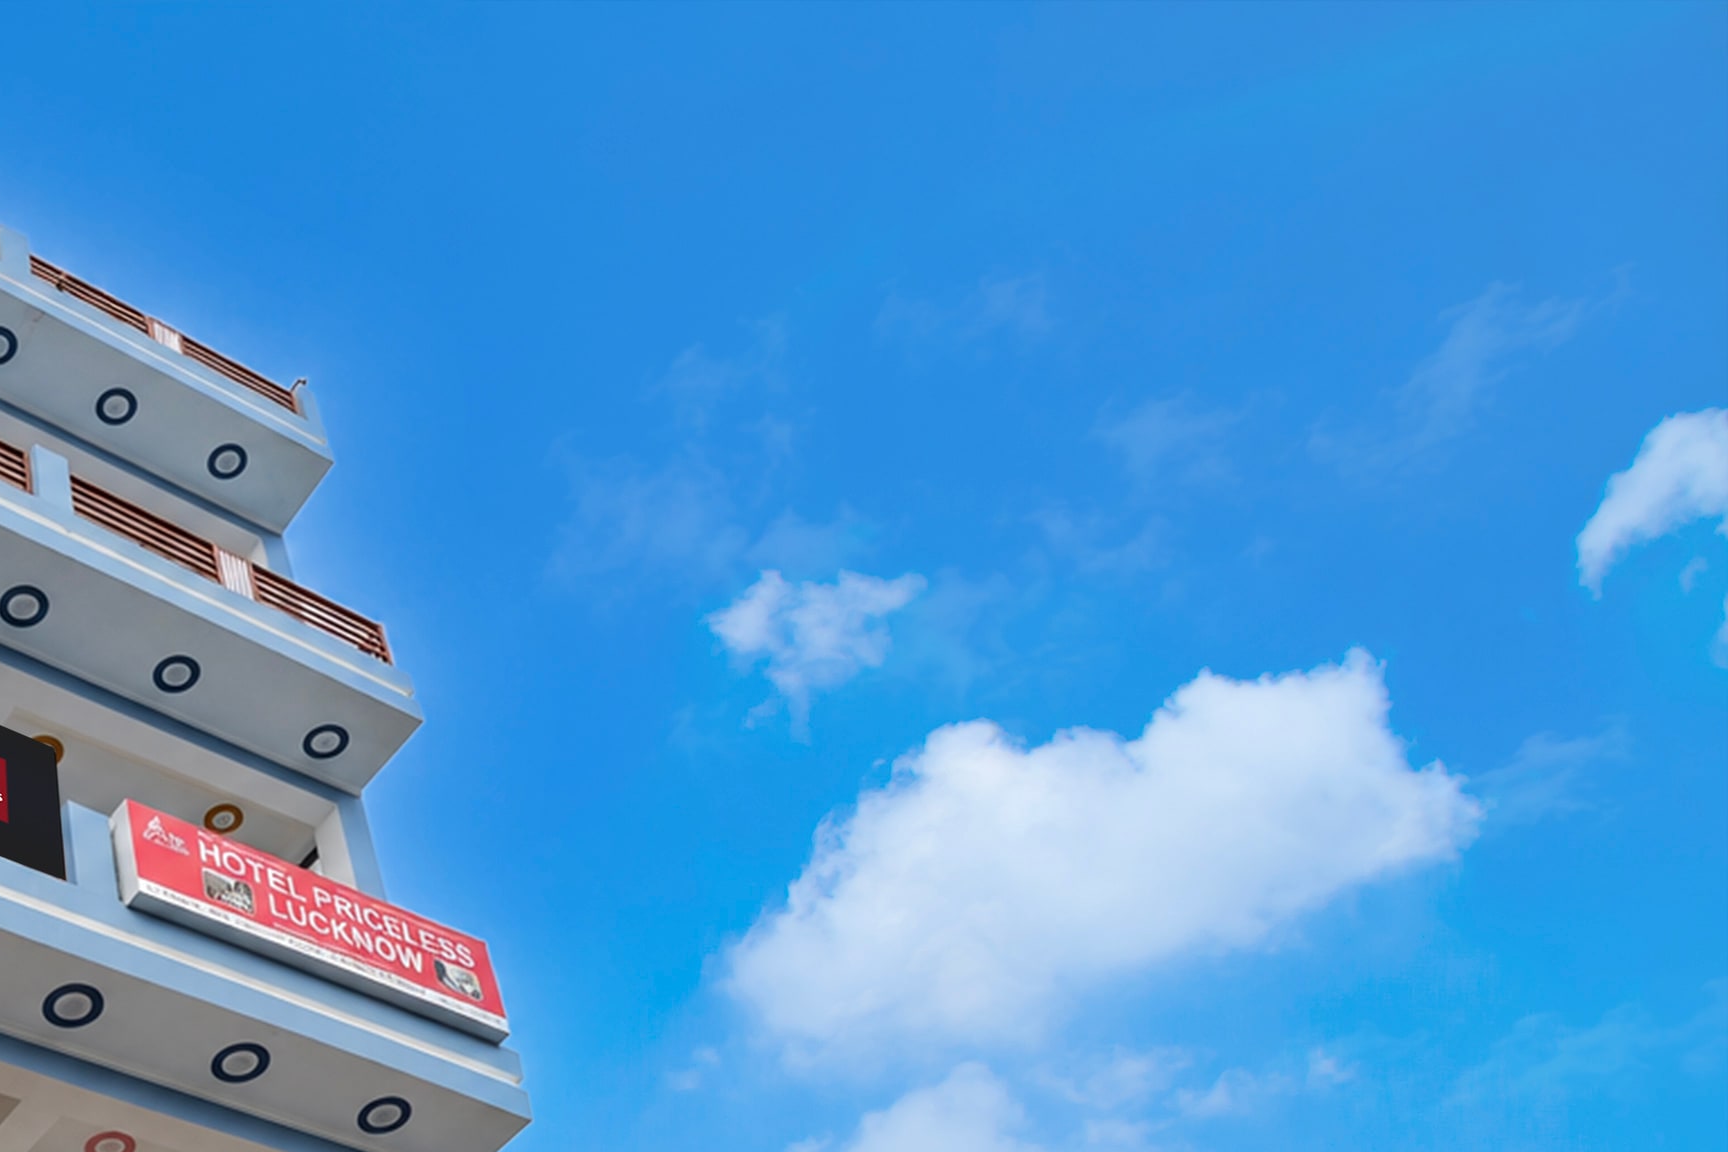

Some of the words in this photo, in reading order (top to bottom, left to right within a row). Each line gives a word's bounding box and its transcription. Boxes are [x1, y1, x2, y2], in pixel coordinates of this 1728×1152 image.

[198, 839, 307, 903] HOTEL
[312, 886, 475, 968] PRICELESS
[268, 893, 423, 973] LUCKNOW
